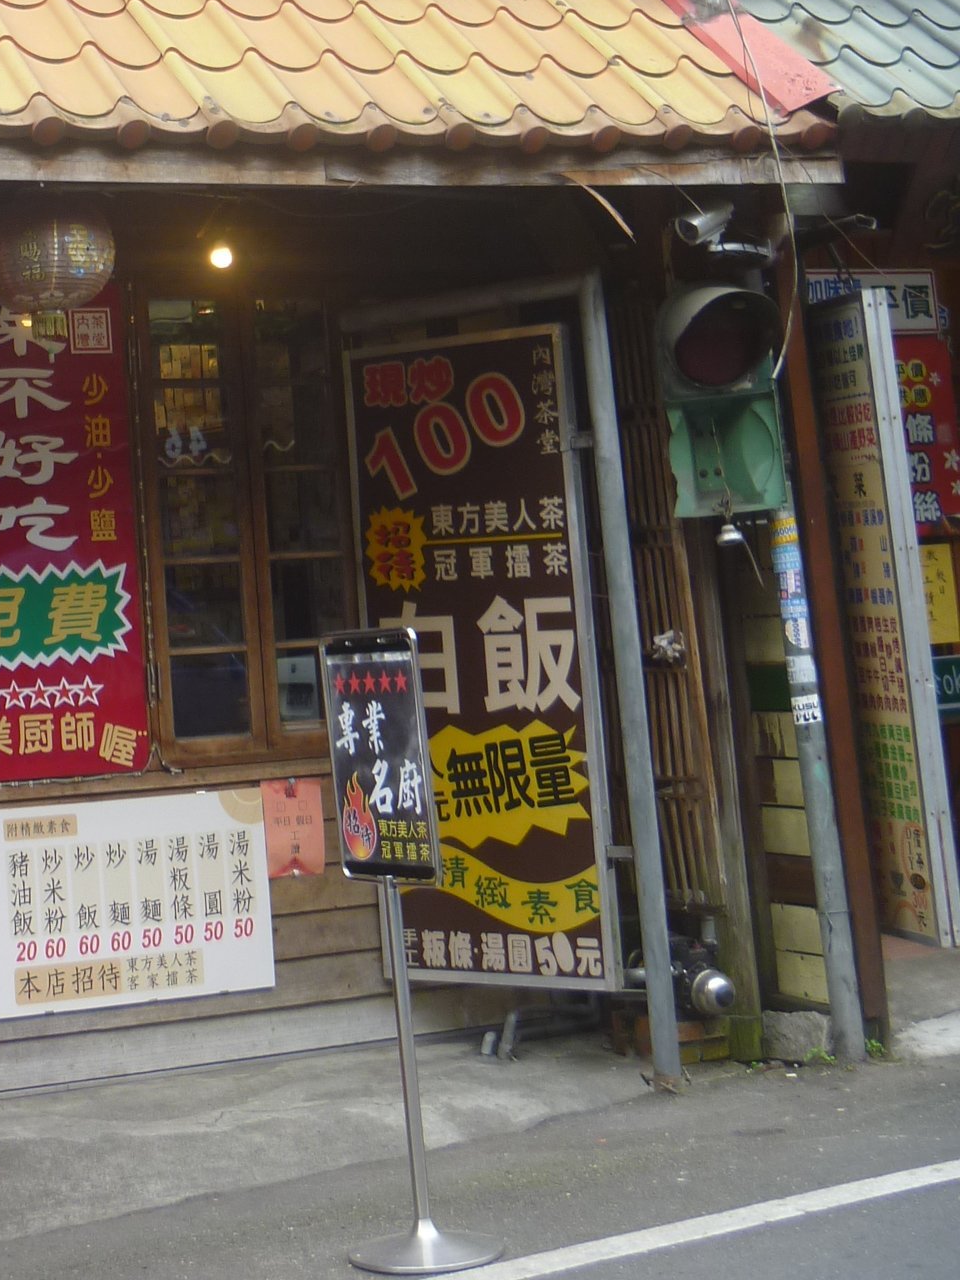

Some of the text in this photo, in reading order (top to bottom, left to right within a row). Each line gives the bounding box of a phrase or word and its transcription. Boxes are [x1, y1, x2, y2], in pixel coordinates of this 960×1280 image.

[364, 356, 454, 407] 現炒
[533, 346, 560, 455] 內灣茶堂
[365, 372, 525, 501] 100
[430, 497, 564, 535] 東方美人茶
[374, 521, 417, 580] 招待
[434, 543, 568, 581] 冠軍擂茶
[379, 595, 581, 715] 白飯
[336, 701, 385, 755] 專業
[447, 735, 577, 817] 無限量
[6, 819, 71, 838] 附精緻素食
[346, 809, 372, 850] 招待
[378, 819, 427, 838] 東方美人茶
[381, 839, 431, 861] 冠軍擂茶
[41, 848, 67, 933] 炒米粉
[74, 845, 100, 930] 炒飯
[105, 842, 131, 927] 炒麵
[137, 838, 162, 923] 湯麵
[168, 836, 193, 920] 湯粄條
[198, 833, 222, 917] 湯圓
[229, 830, 254, 914] 湯米粉
[402, 855, 600, 925] 精緻素食
[10, 851, 35, 936] 豬油飯
[46, 937, 66, 958] 60
[80, 934, 100, 955] 60
[111, 931, 131, 952] 60
[142, 928, 162, 948] 50
[174, 924, 194, 945] 50
[204, 921, 223, 942] 50
[234, 917, 254, 938] 50
[17, 941, 37, 962] 20
[127, 951, 197, 972] 東方美人茶
[18, 962, 121, 999] 本店招待
[128, 969, 198, 991] 客家擂茶
